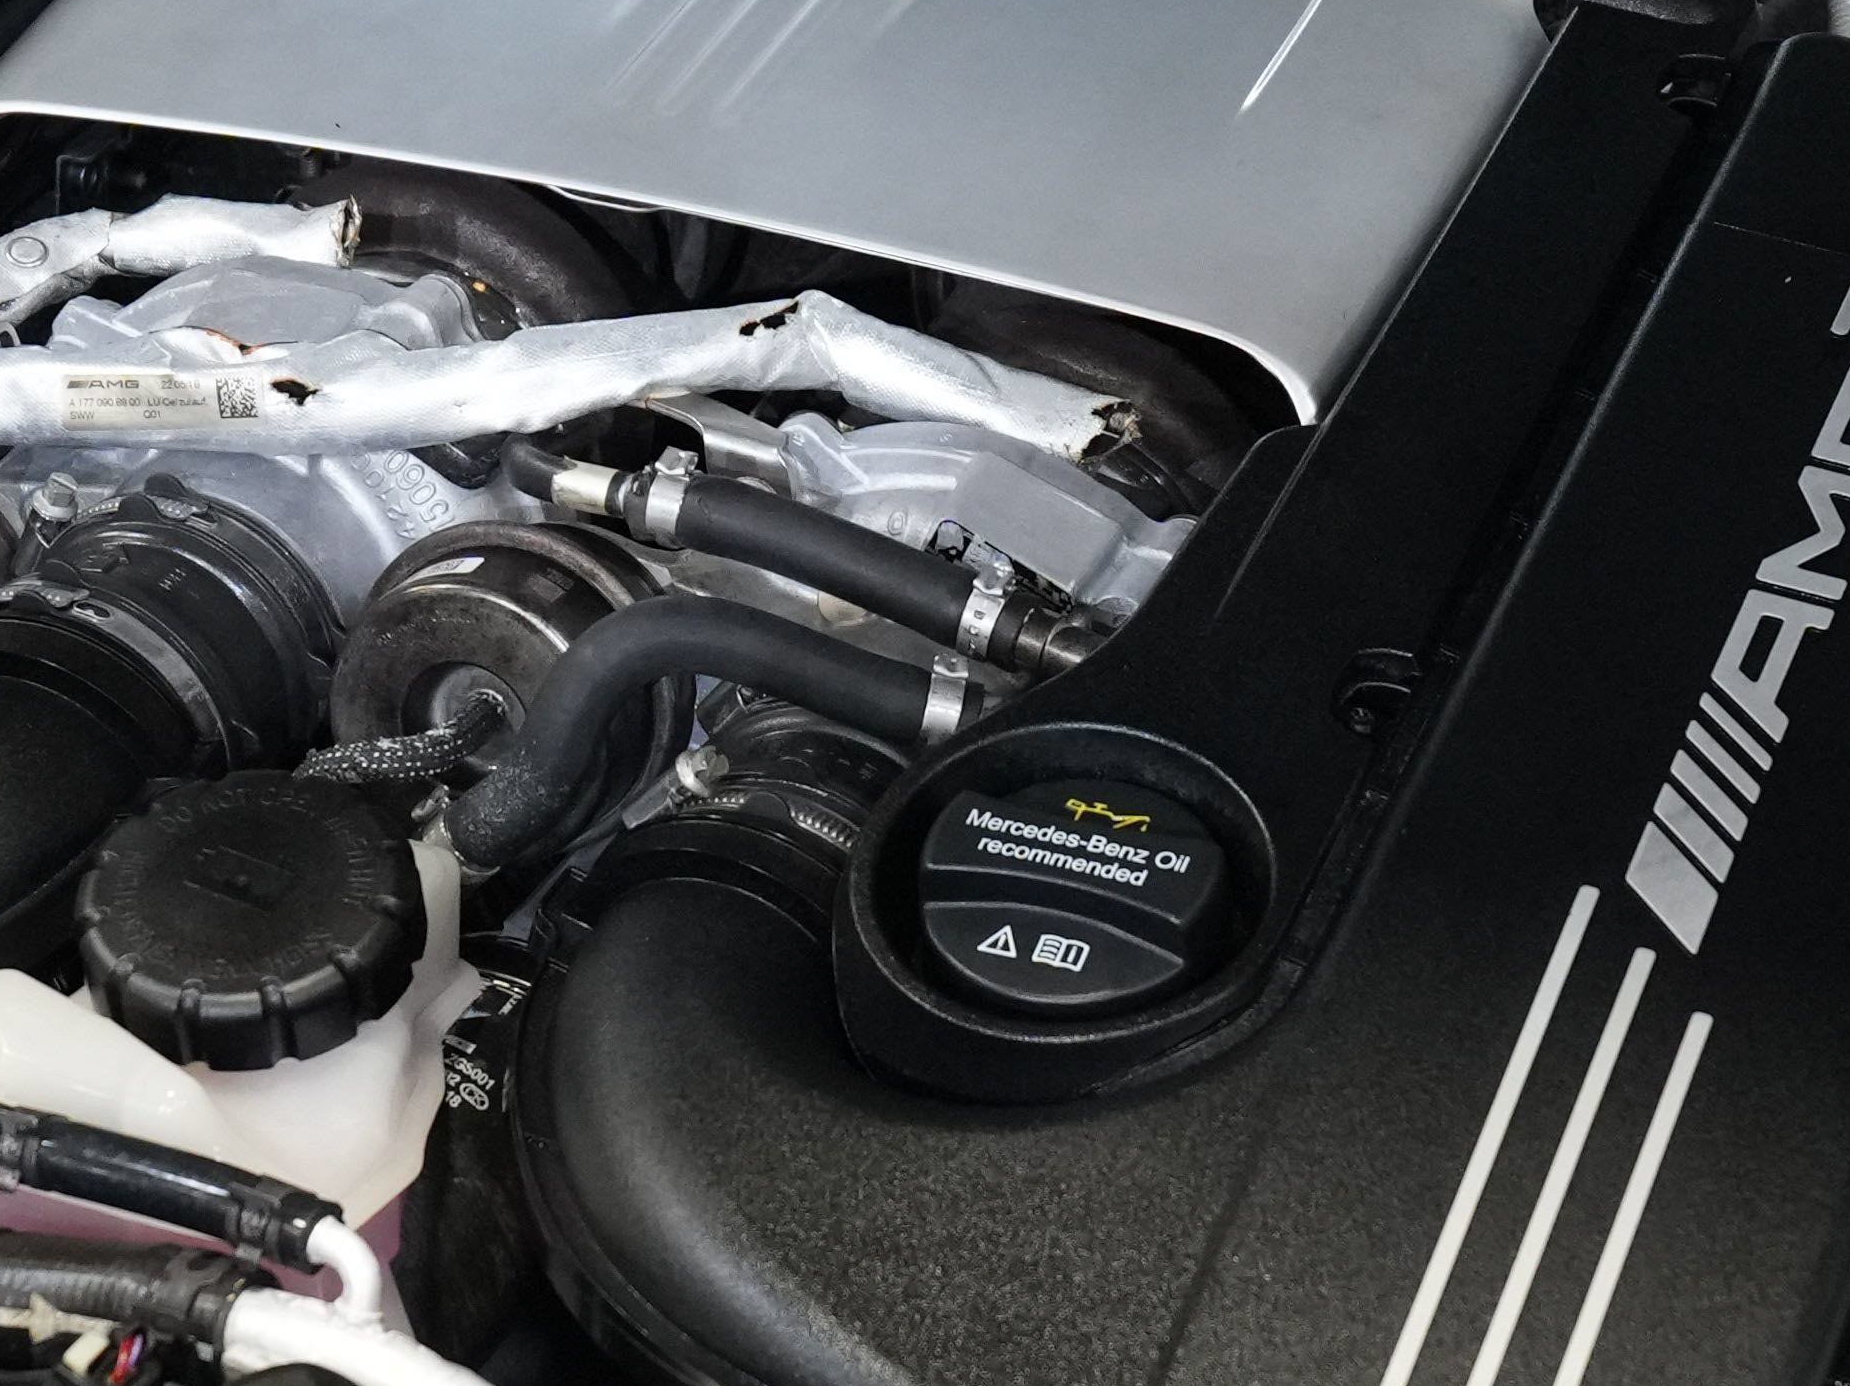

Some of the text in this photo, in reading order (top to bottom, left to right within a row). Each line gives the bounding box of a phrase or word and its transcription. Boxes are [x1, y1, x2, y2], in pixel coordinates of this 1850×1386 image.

[965, 808, 1191, 875] Mercedes-Benz Oil
[977, 833, 1148, 888] recommended
